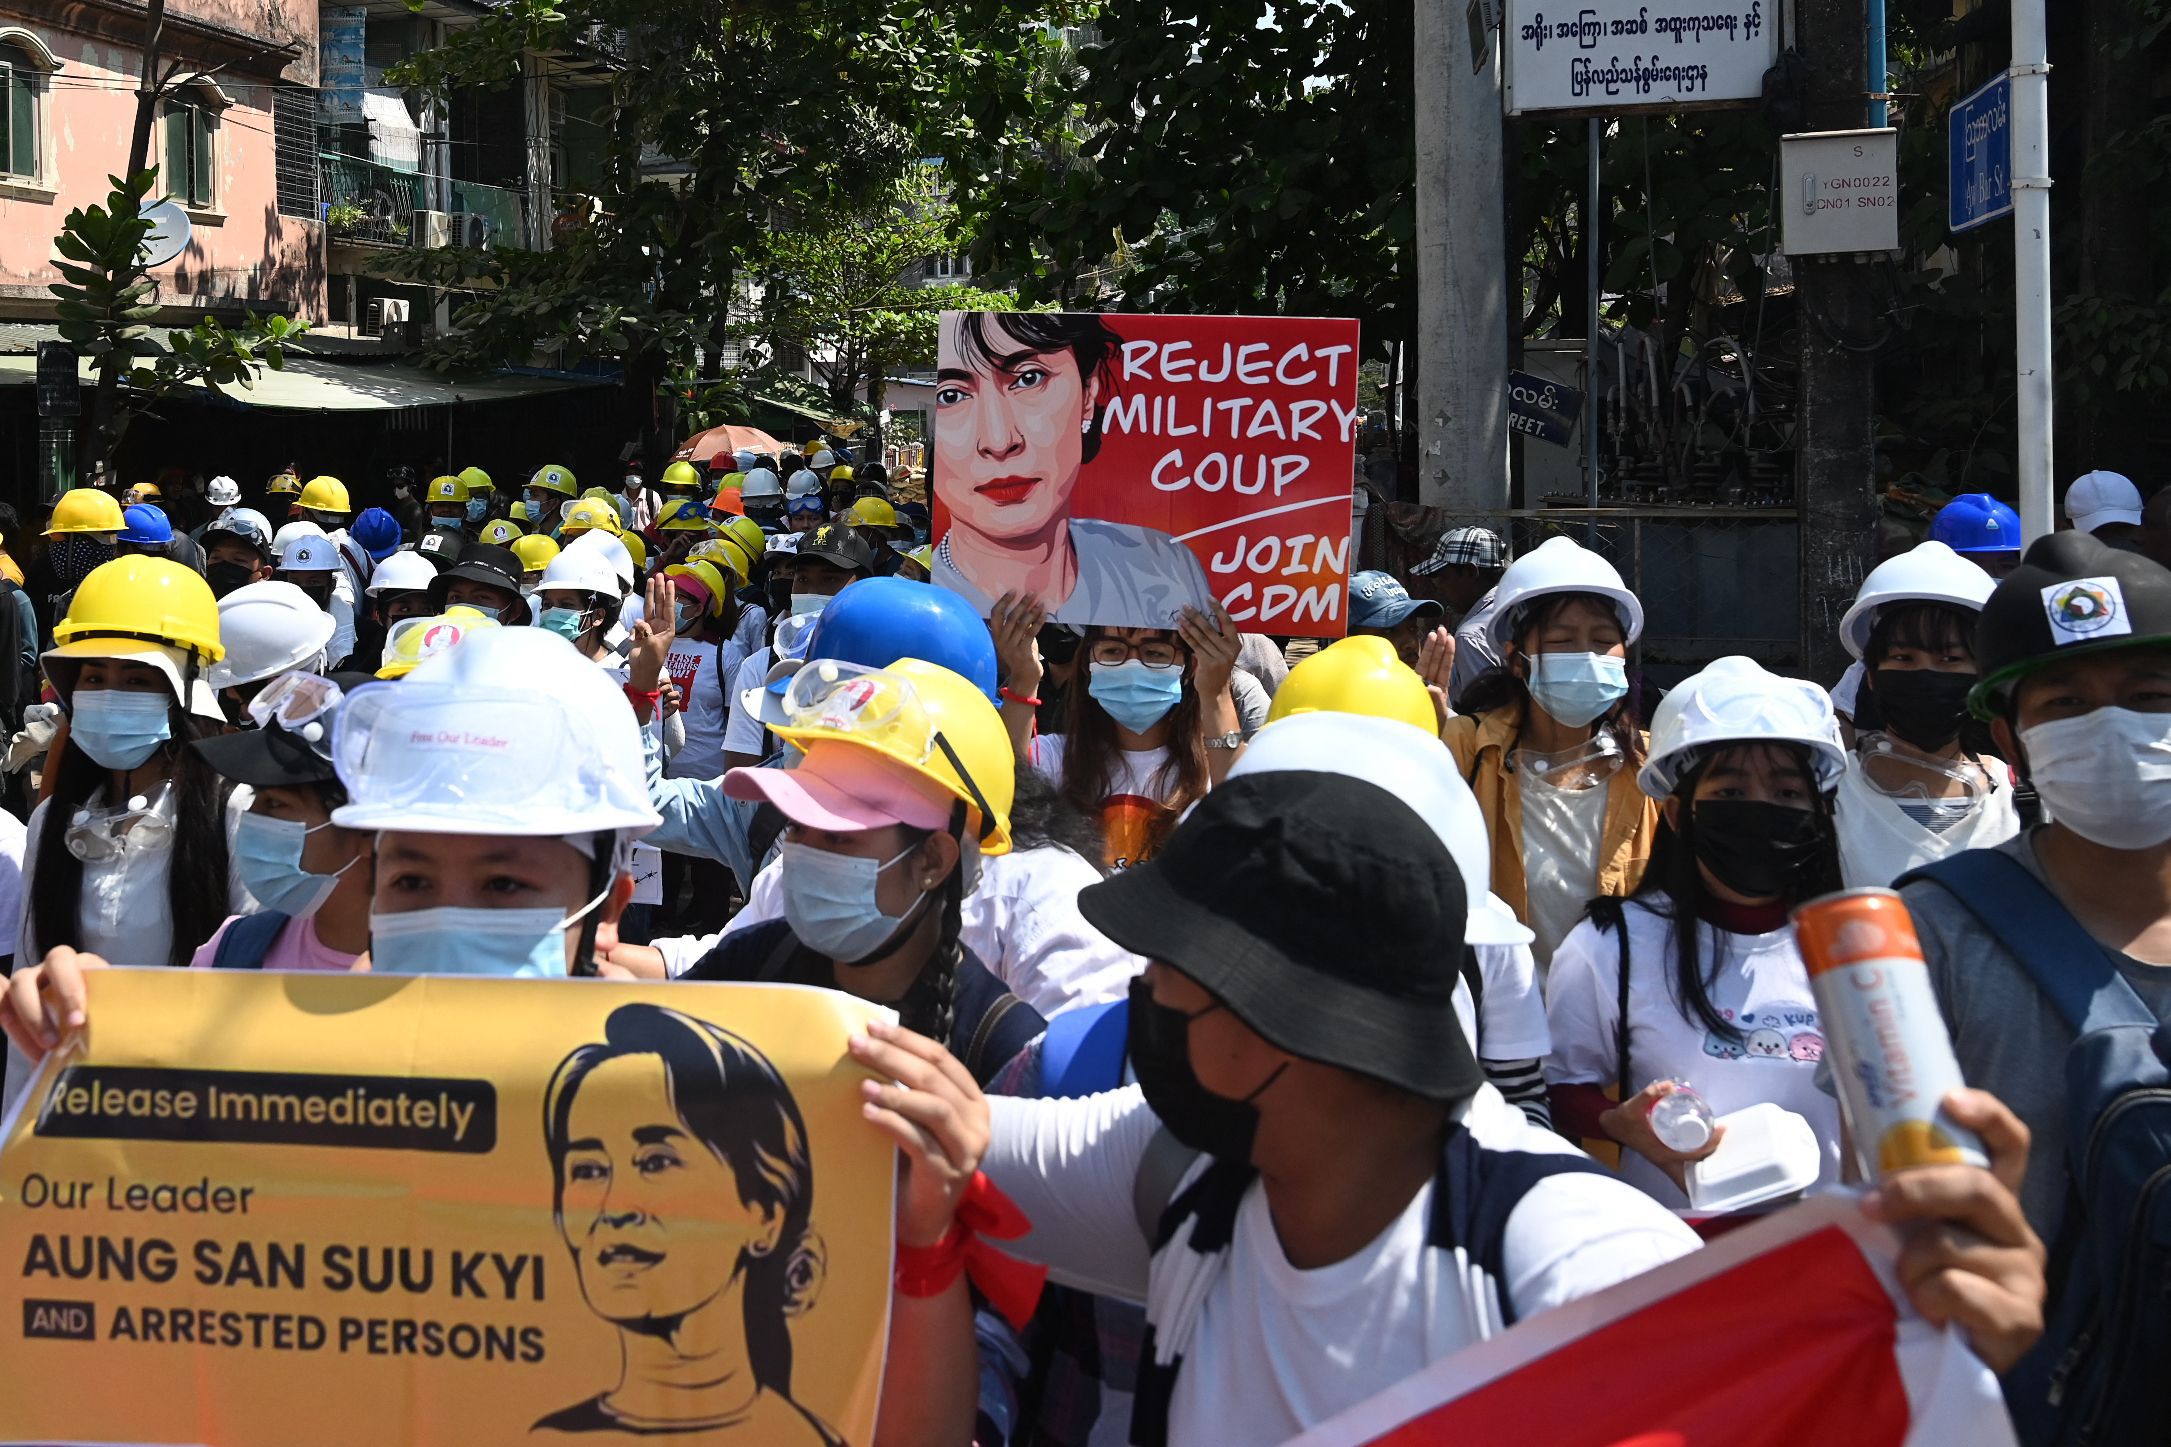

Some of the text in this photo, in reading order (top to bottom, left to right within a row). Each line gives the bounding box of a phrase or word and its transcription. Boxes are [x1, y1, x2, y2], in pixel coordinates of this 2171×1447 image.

[1853, 145, 1864, 158] S
[1823, 176, 1890, 190] YGN0022
[1857, 196, 1896, 208] SN02
[1121, 339, 1352, 387] REJECT
[1101, 393, 1357, 443] MILITARY
[1509, 412, 1545, 437] REET.
[1150, 448, 1310, 497] COUP
[1211, 534, 1351, 576] JOIN
[1221, 582, 1341, 623] CDM
[667, 652, 696, 665] LEASE
[438, 731, 461, 744] Our
[464, 732, 508, 747] Leader
[50, 1080, 475, 1140] Release Immediately
[21, 1173, 254, 1214] Our Leader
[22, 1234, 544, 1301] AUNG SAN SUU KYI
[31, 1306, 545, 1364] AND ARRESTED PERSONS
